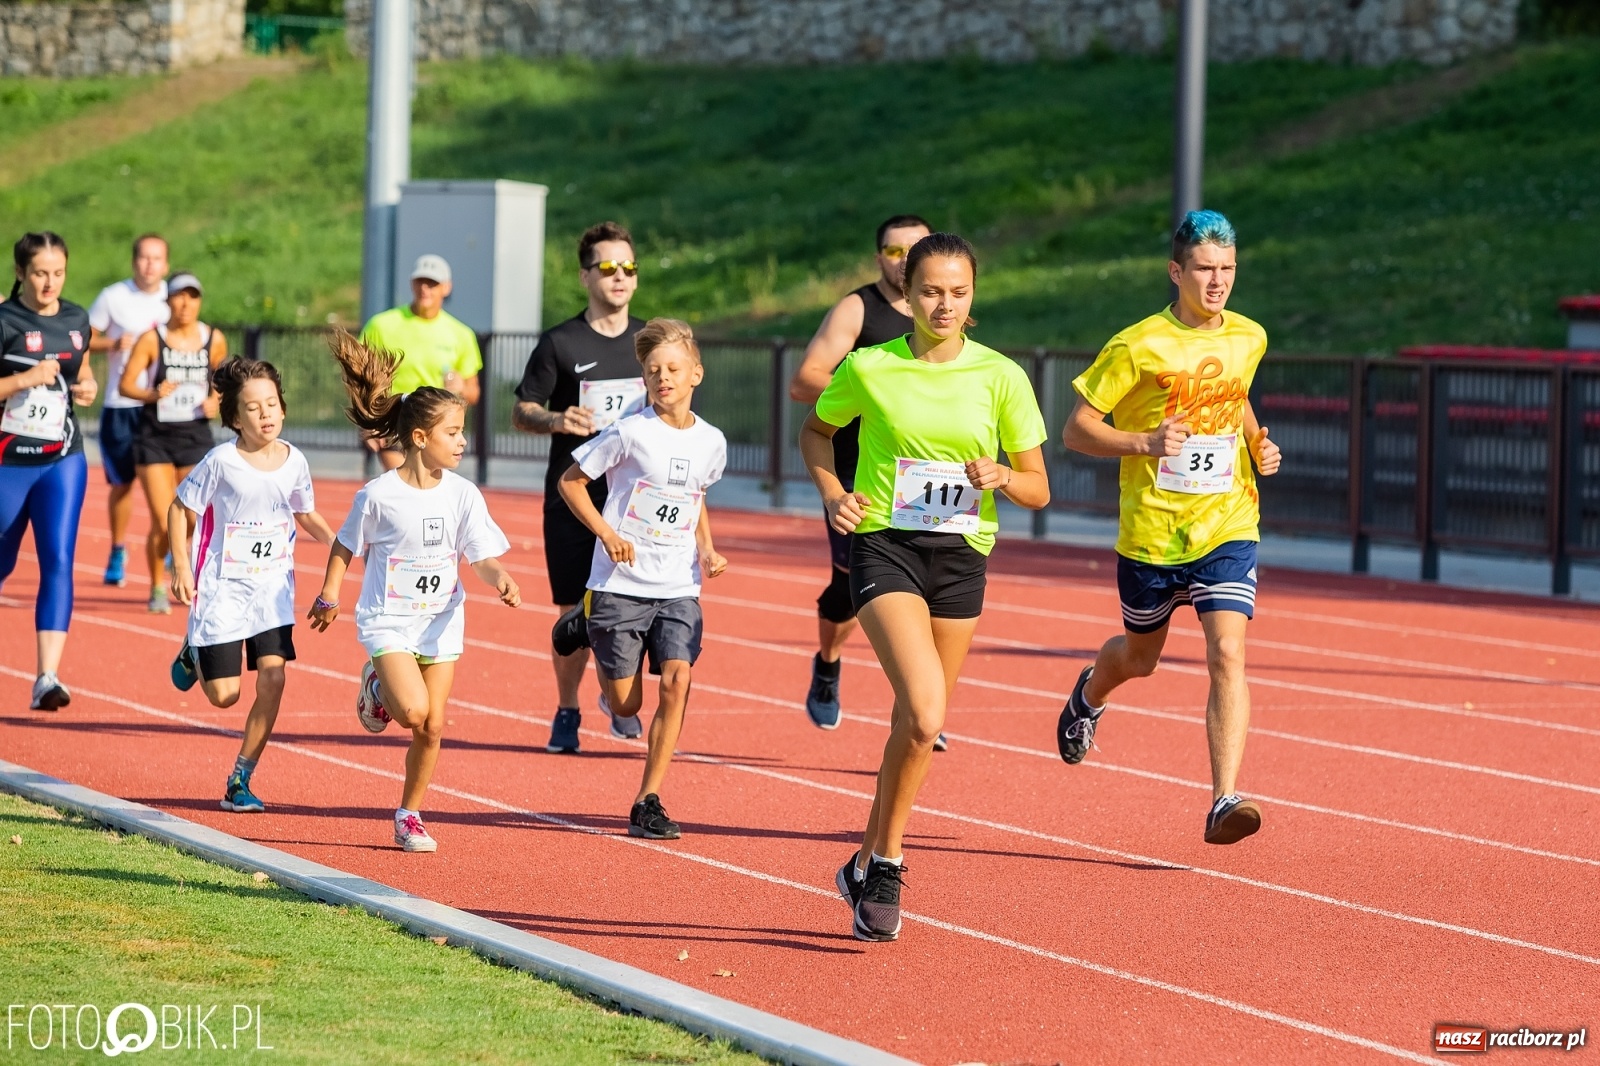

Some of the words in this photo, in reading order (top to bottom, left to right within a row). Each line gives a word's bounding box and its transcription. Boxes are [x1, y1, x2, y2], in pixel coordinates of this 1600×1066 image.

[27, 404, 48, 420] 39
[605, 395, 624, 411] 37
[1189, 452, 1215, 472] 35
[923, 480, 964, 508] 117
[655, 504, 679, 524] 48
[250, 540, 272, 559] 42
[415, 574, 441, 594] 49
